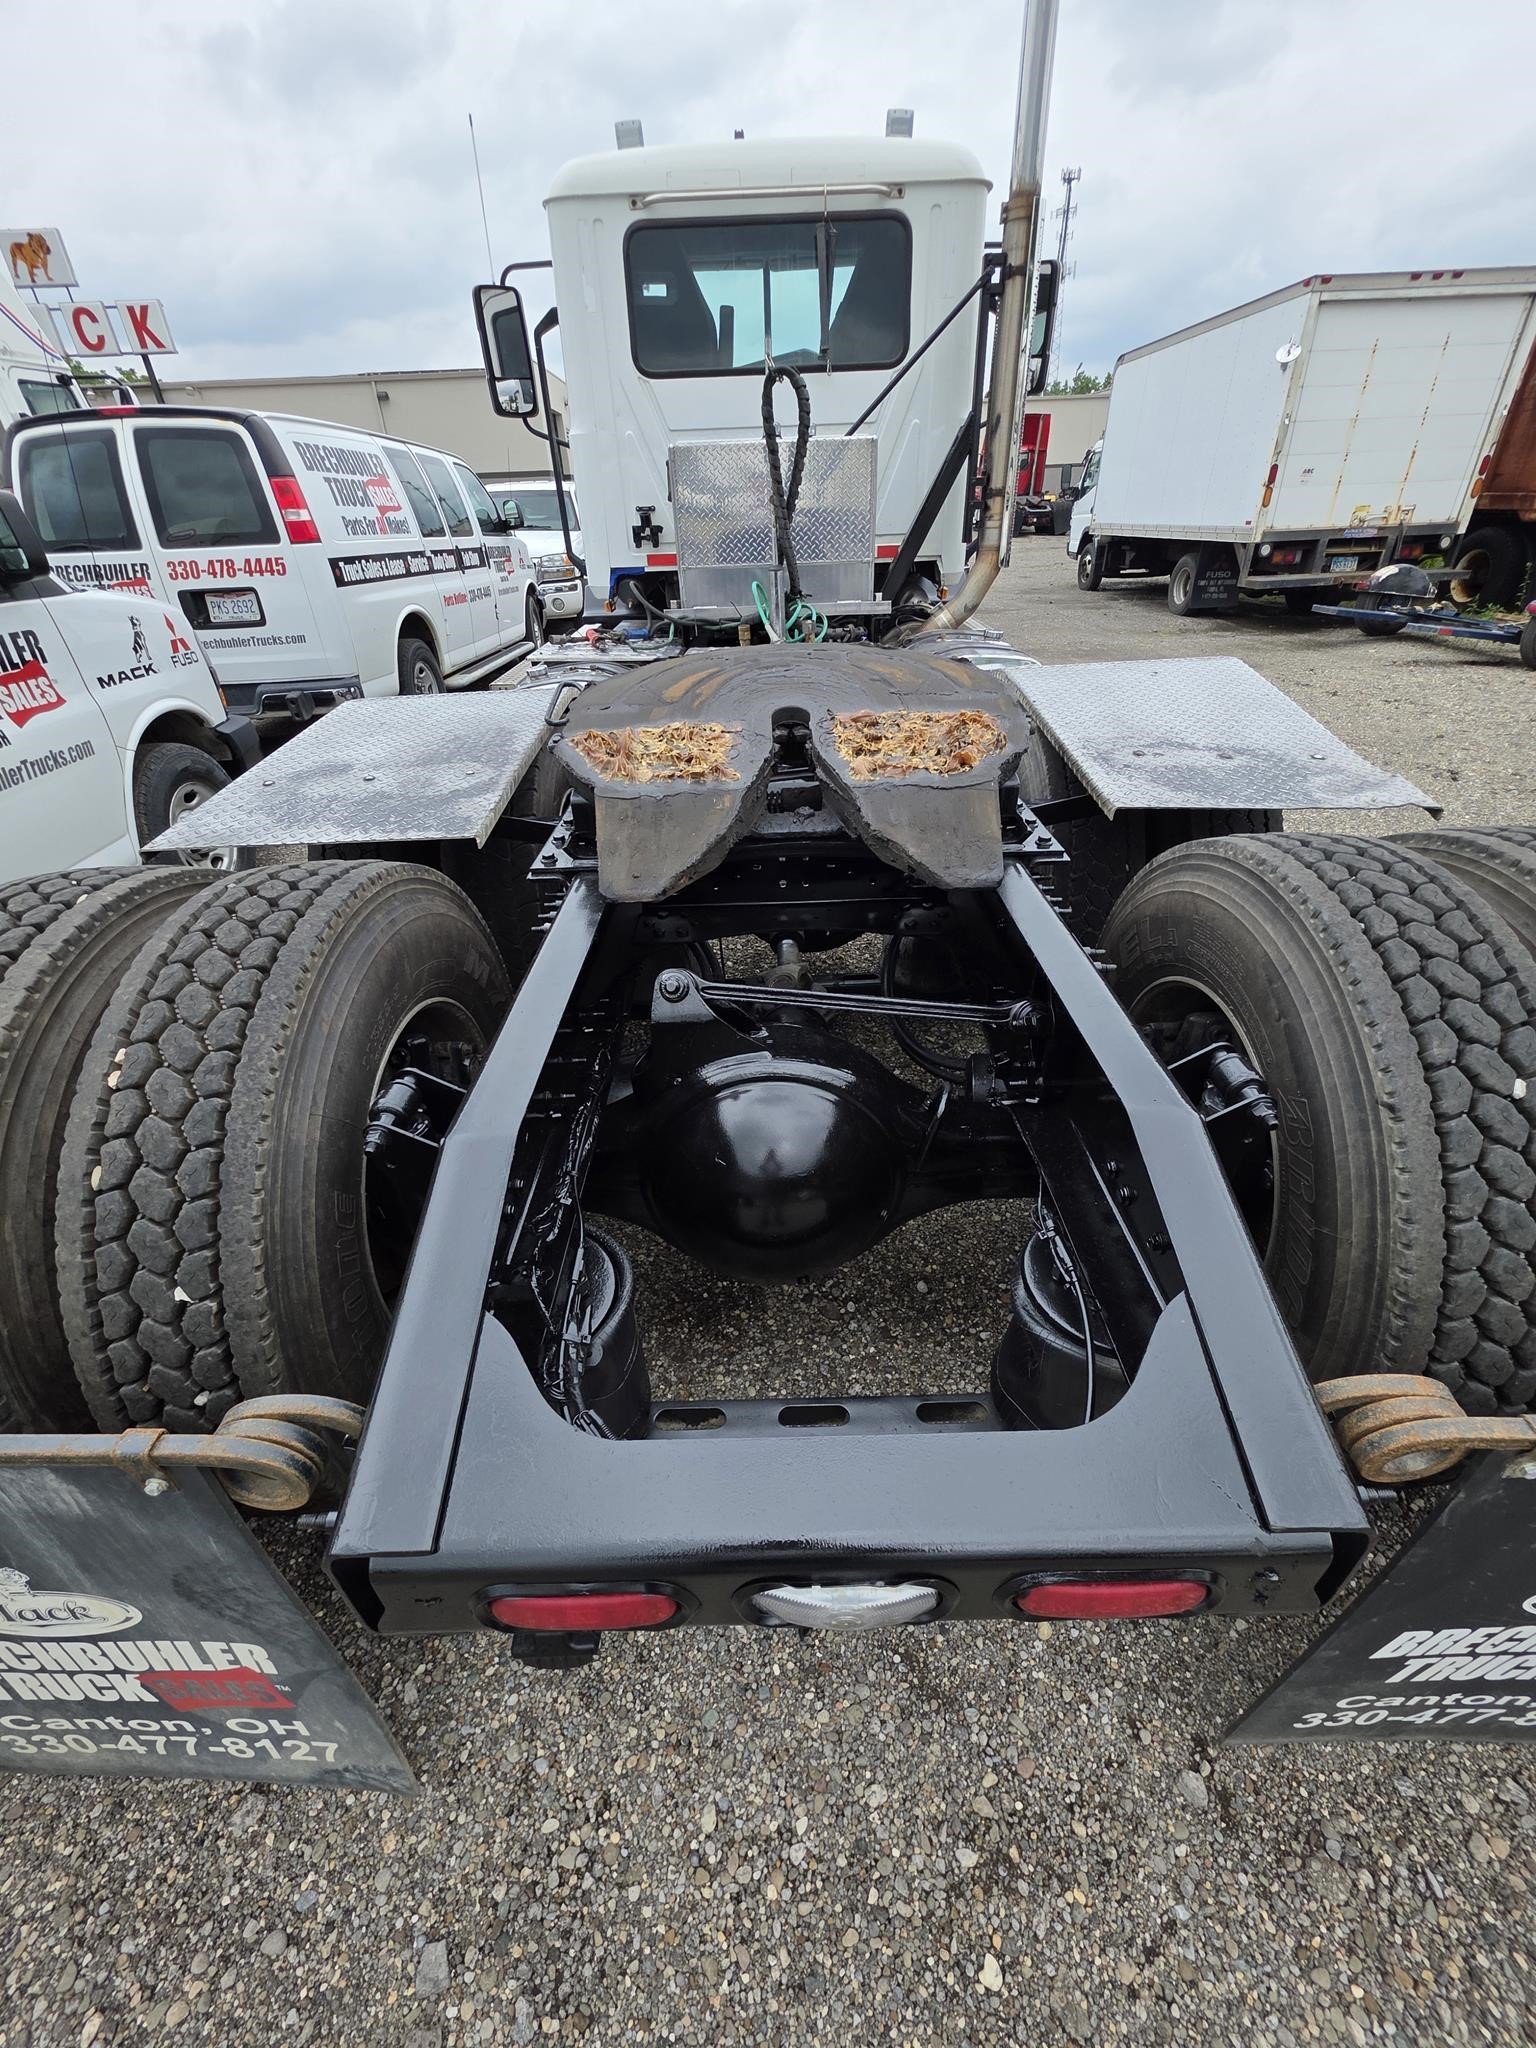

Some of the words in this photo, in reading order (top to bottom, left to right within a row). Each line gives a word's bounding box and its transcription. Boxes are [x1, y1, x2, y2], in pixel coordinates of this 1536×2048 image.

[322, 476, 375, 508] TRUCK
[366, 485, 400, 507] SALES
[341, 515, 367, 536] Parts
[362, 515, 379, 535] For
[166, 556, 287, 581] 330-478-4445
[338, 560, 364, 582] Truck
[361, 558, 383, 579] Sales
[385, 557, 406, 576] Lease
[407, 555, 430, 574] Service
[210, 600, 230, 615] PKS
[230, 599, 256, 615] 2692
[201, 634, 307, 650] echbuhlerTrucks.com
[171, 651, 199, 668] FUSO
[96, 663, 158, 689] MACK
[0, 677, 58, 714] SALES
[150, 1678, 278, 1703] SALES
[0, 1715, 212, 1735] Canton,
[225, 1717, 311, 1736] OH
[0, 1734, 338, 1762] 330-477-8127
